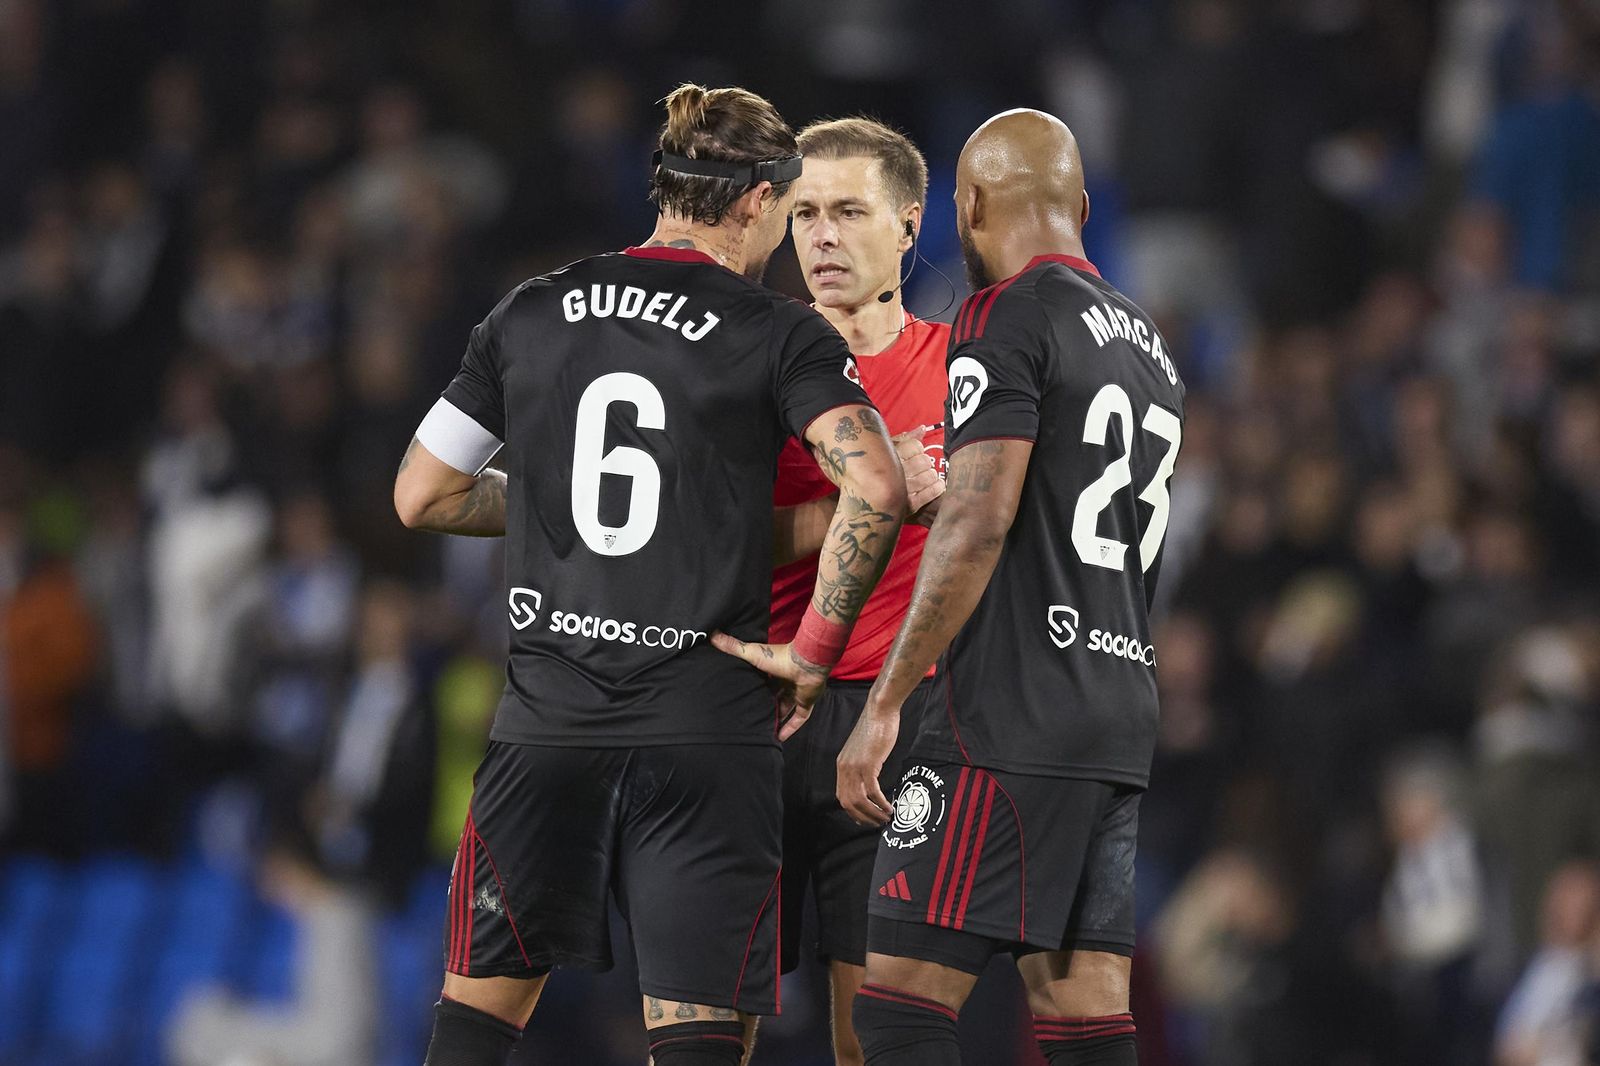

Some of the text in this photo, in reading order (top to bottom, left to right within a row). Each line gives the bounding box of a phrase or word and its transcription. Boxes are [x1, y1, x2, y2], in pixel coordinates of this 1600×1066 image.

[562, 284, 720, 341] GUDELJ
[571, 371, 666, 557] 6
[1071, 384, 1182, 574] 27
[920, 766, 945, 789] TIME
